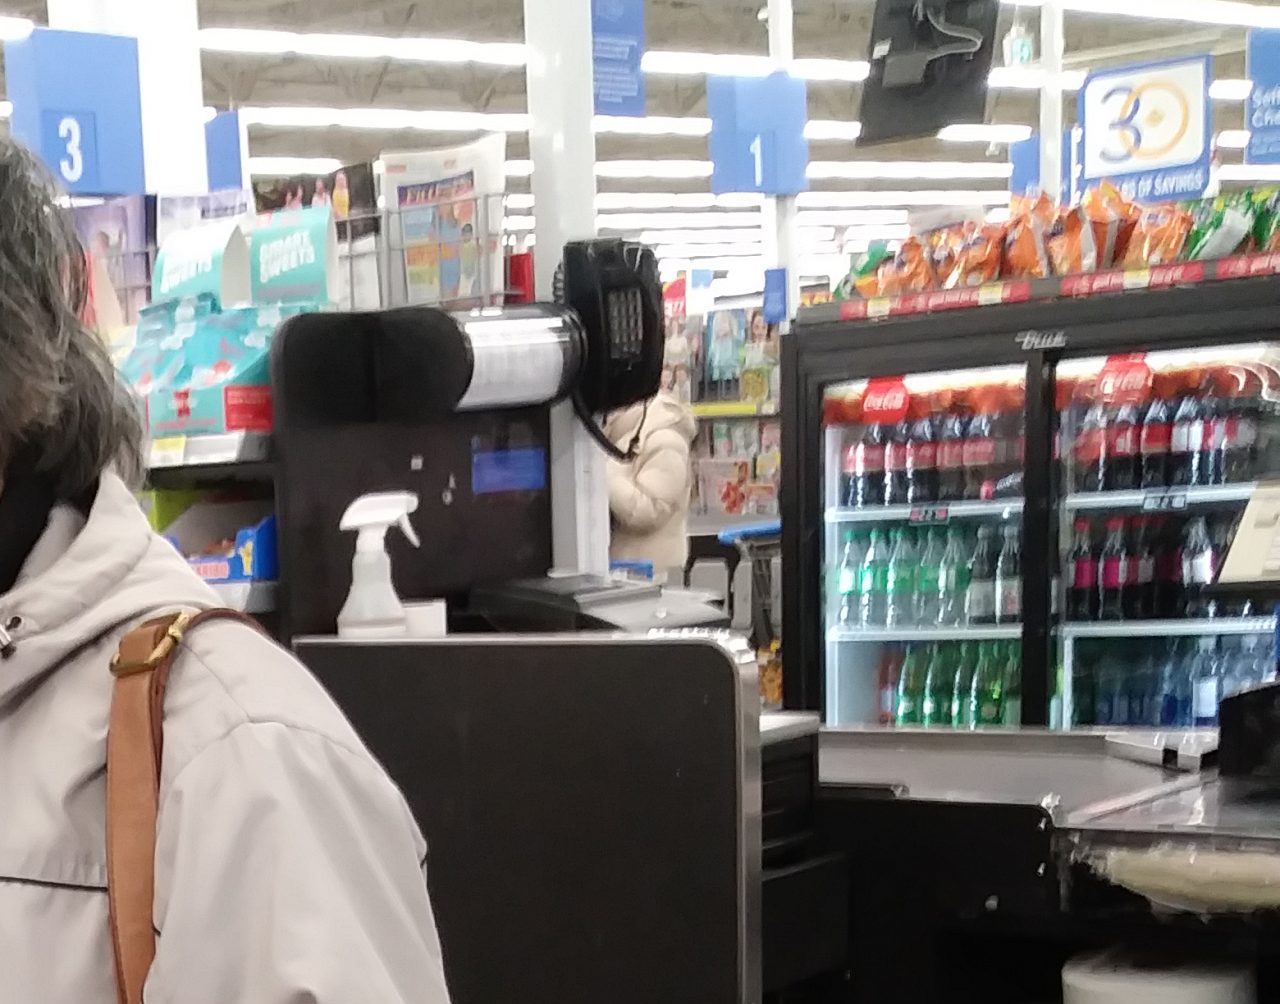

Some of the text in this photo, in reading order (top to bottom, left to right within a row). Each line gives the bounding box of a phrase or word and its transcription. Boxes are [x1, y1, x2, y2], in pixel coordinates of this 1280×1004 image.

[58, 116, 83, 183] 3
[1099, 80, 1189, 164] 30
[749, 134, 762, 187] 1
[1154, 171, 1203, 195] SAVINGS
